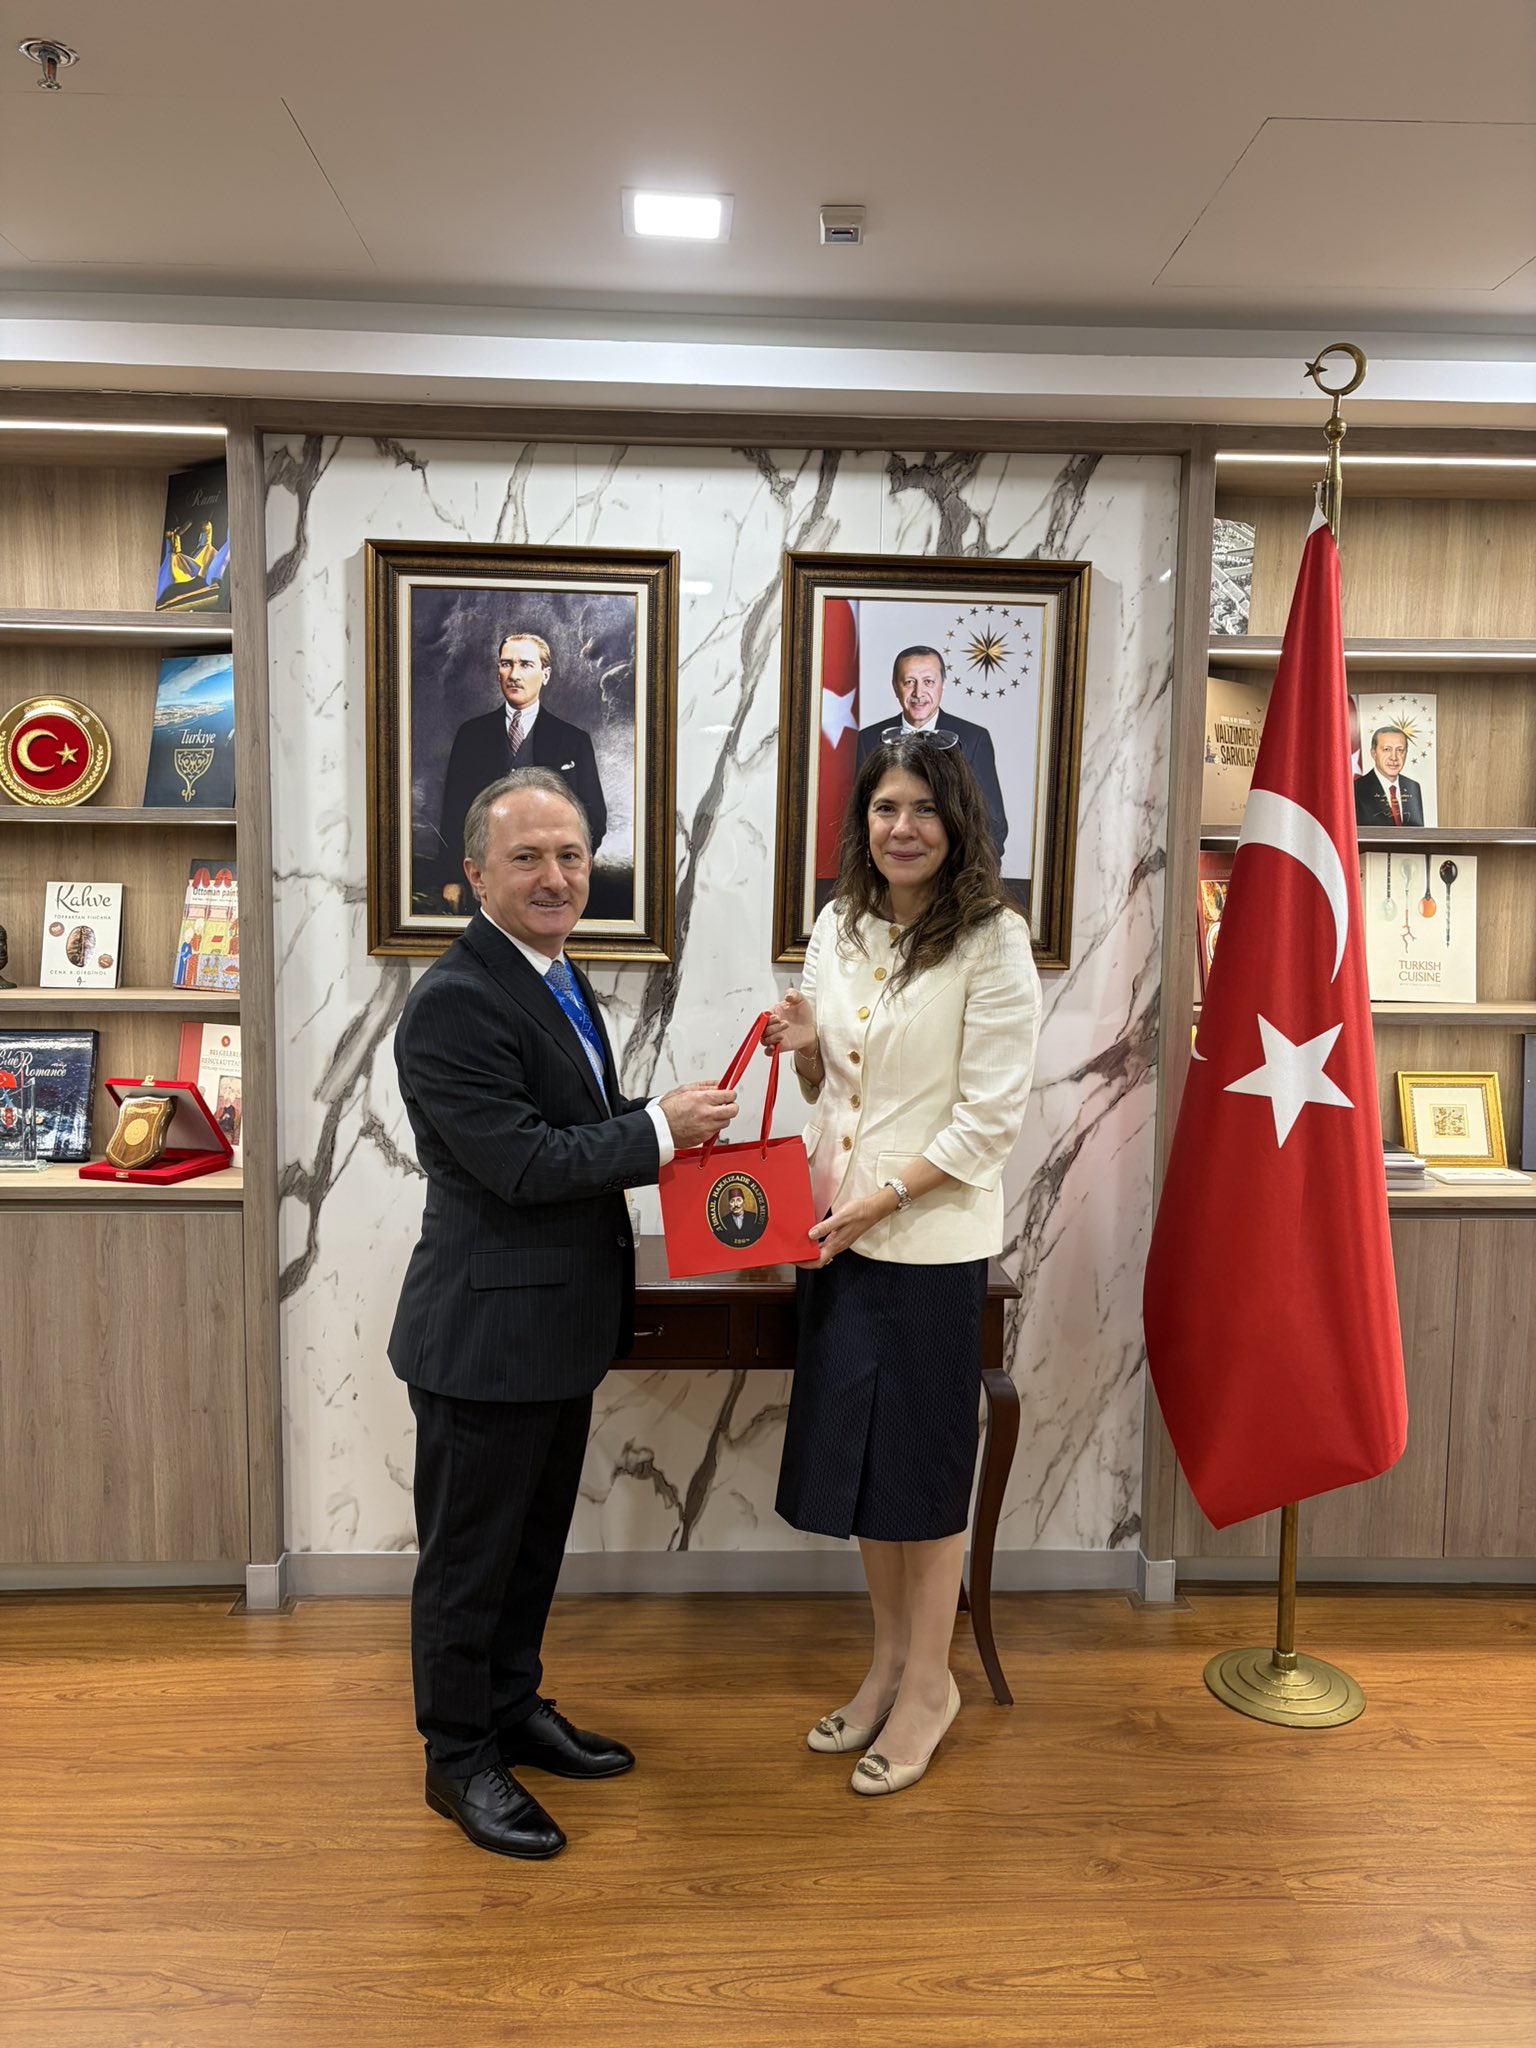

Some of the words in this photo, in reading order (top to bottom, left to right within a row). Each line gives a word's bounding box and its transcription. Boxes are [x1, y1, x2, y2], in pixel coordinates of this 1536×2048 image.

[191, 488, 222, 507] Rumi
[56, 884, 113, 914] Kahve
[1398, 960, 1441, 971] TURKISH
[1398, 971, 1441, 983] CUISINE
[13, 1050, 68, 1077] Romance
